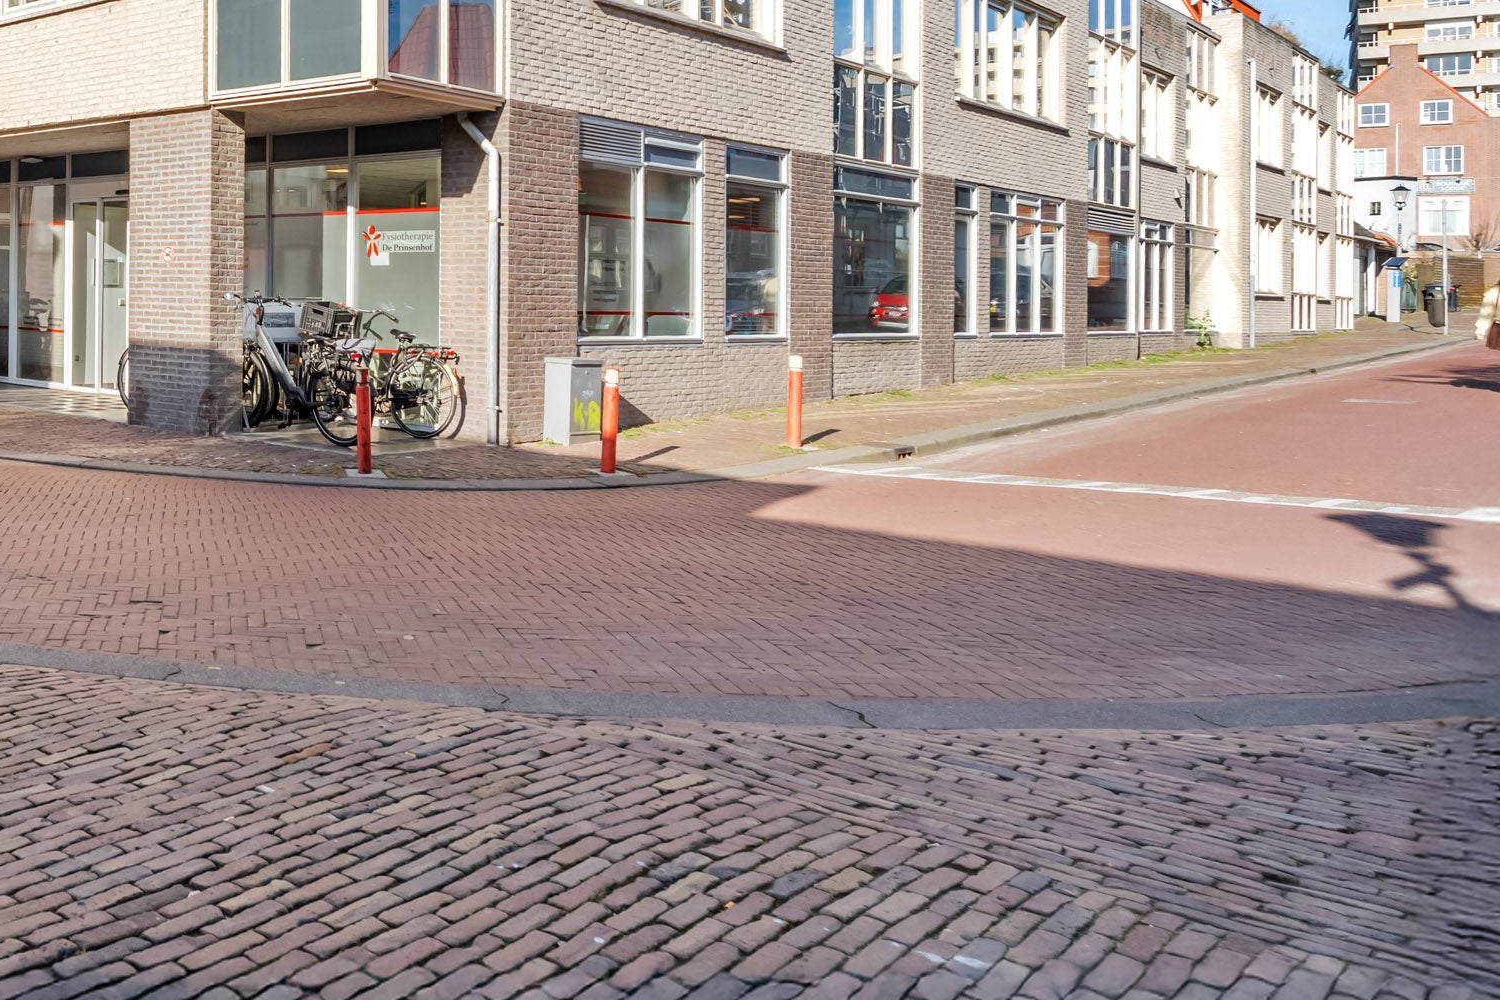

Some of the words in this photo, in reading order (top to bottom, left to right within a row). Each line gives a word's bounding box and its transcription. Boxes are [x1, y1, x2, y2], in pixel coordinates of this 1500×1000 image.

[382, 232, 434, 242] Fysiotherapie
[382, 244, 392, 252] De
[394, 243, 434, 252] Prinsenhof
